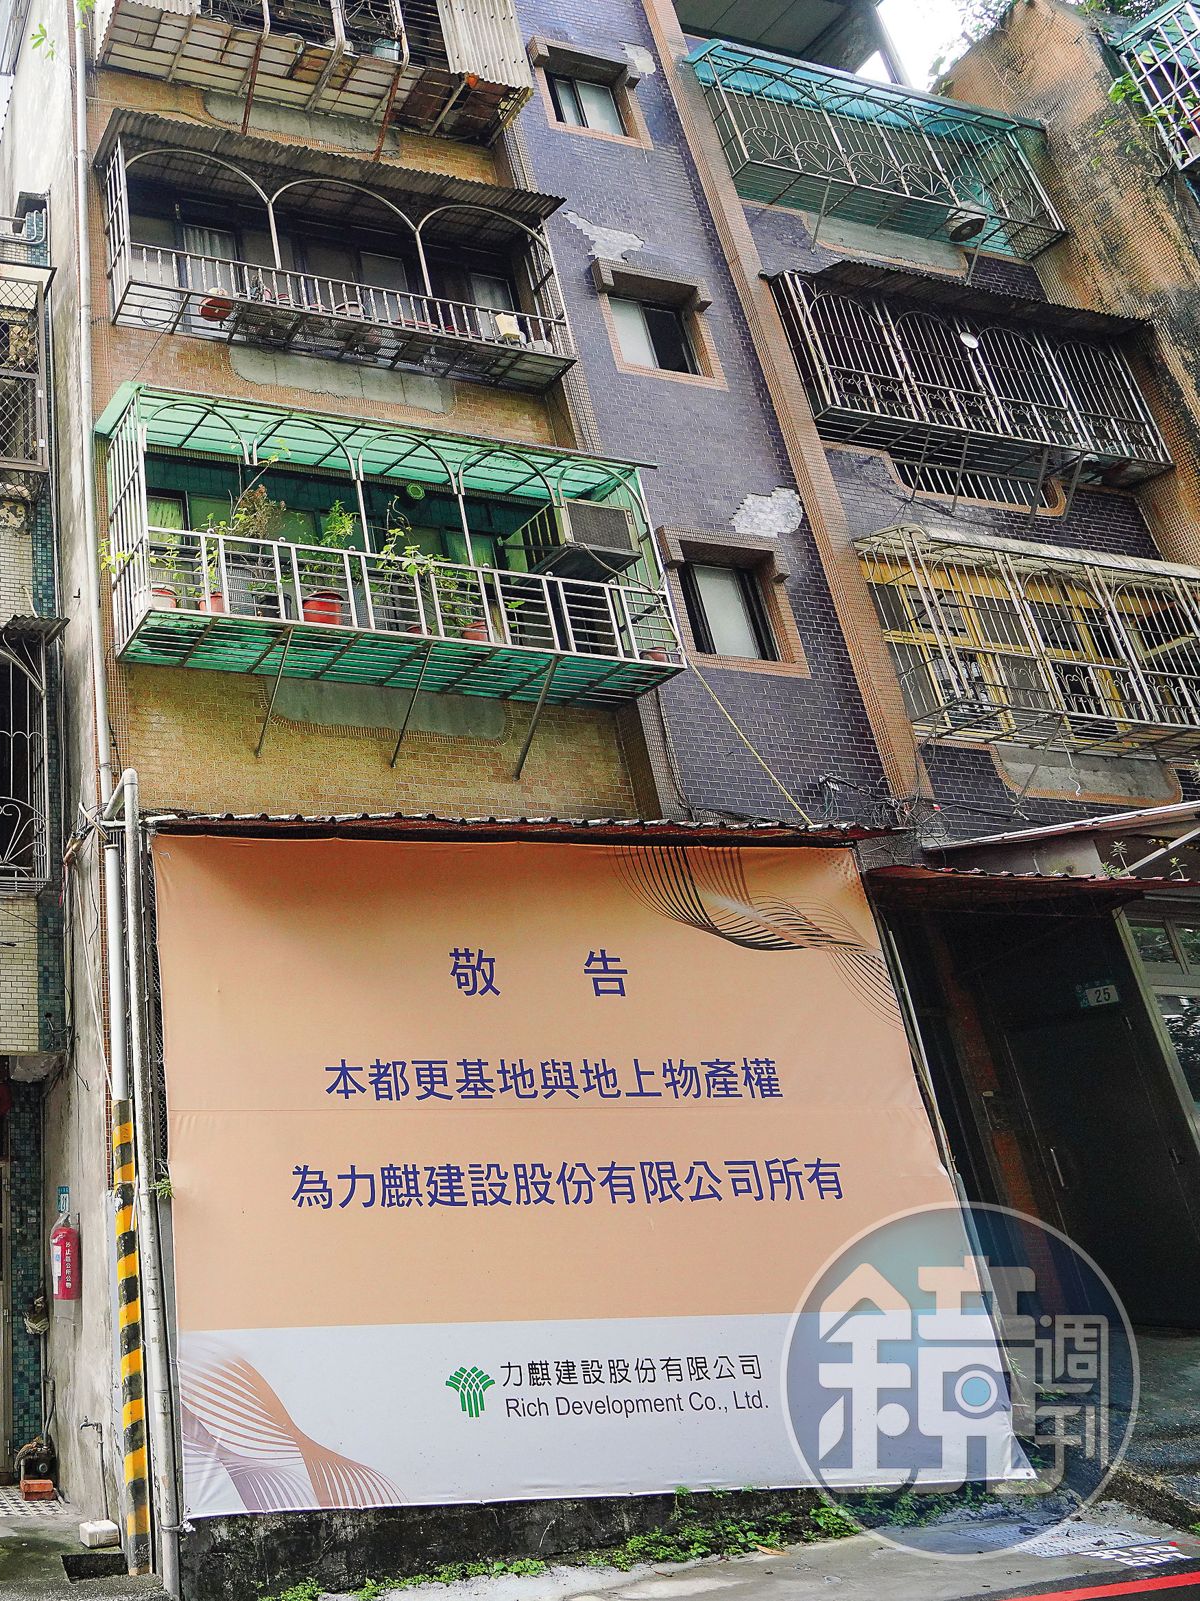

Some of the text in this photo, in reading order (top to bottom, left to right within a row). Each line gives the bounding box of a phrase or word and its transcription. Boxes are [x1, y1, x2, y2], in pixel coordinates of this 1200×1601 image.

[1095, 988, 1111, 1003] 25
[324, 1057, 784, 1103] 本都更基地與地上物產權
[290, 1156, 844, 1210] 為力麒建設股份有限公司所有
[500, 1354, 763, 1387] 力麒建設股份有限公司
[505, 1389, 770, 1419] Rich Development Co., Ltd.
